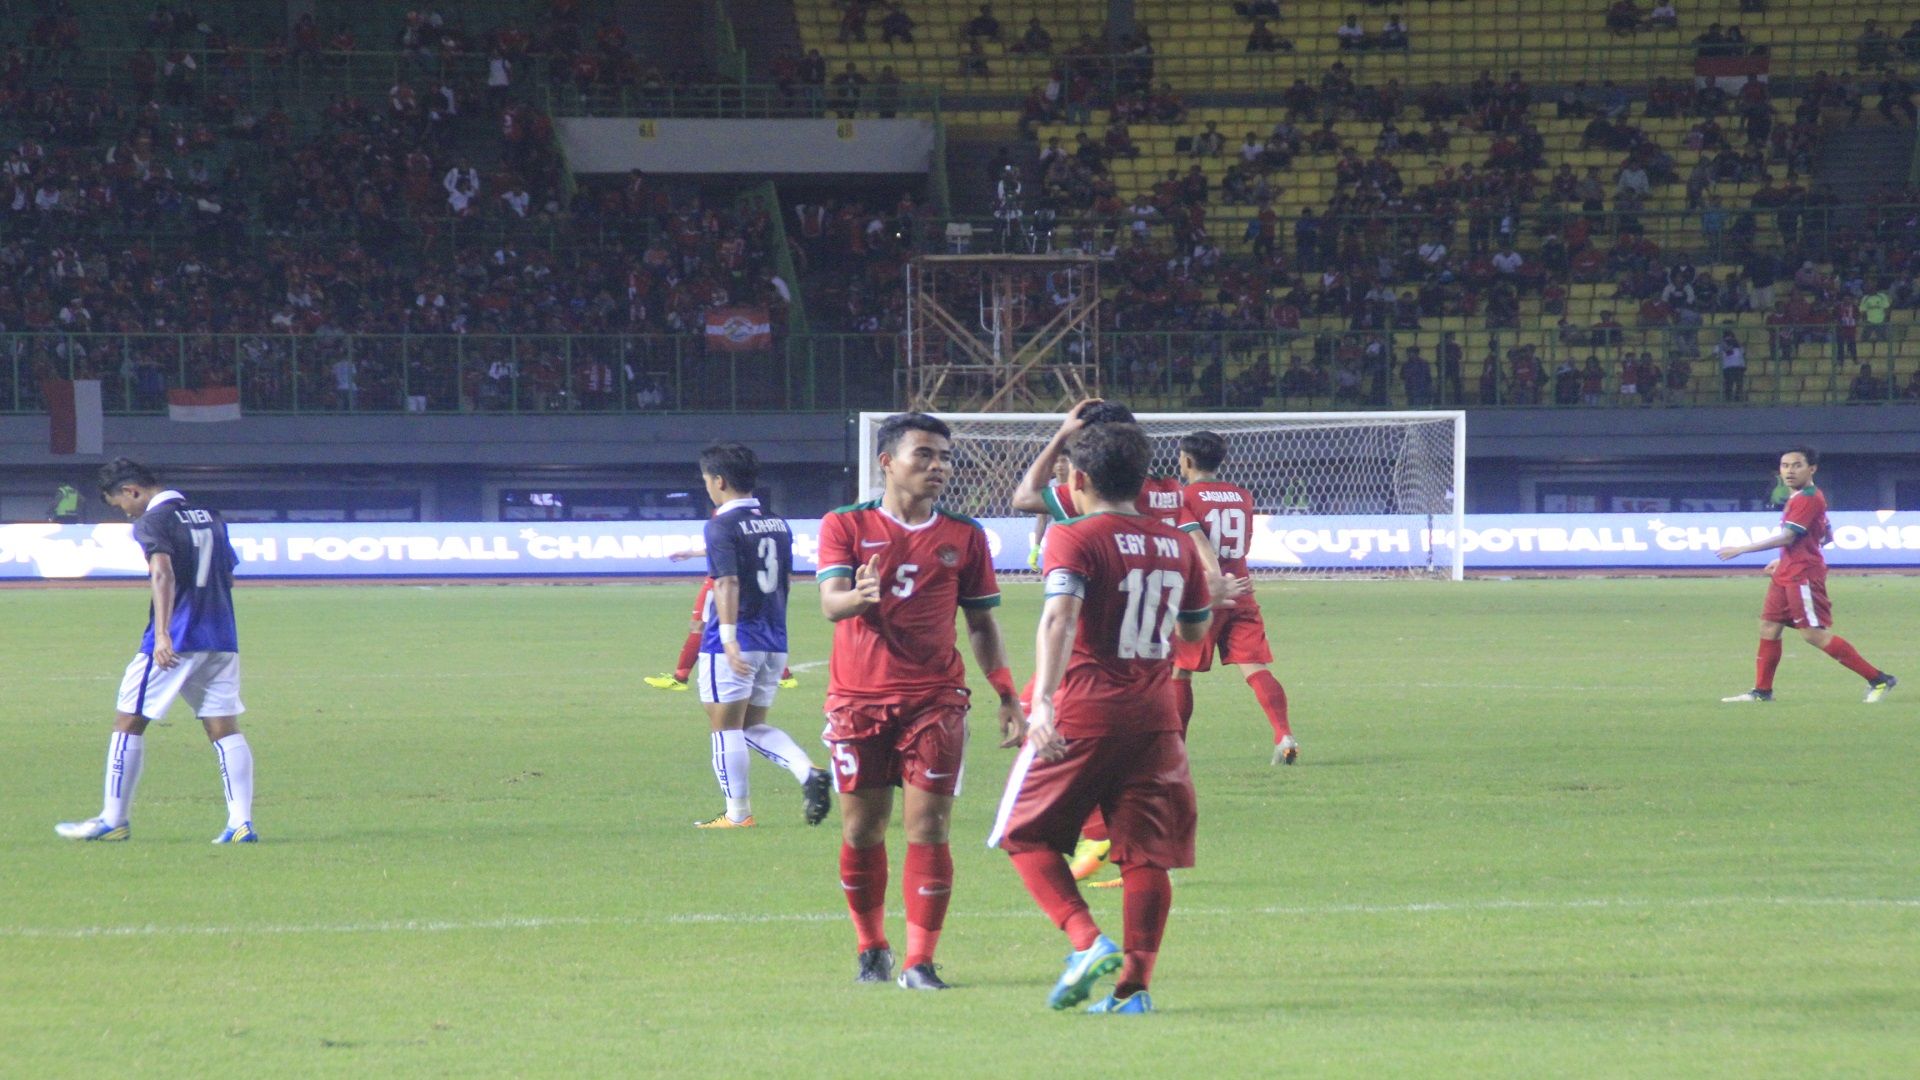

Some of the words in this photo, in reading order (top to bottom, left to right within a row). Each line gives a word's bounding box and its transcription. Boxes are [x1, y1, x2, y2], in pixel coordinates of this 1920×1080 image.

[1198, 490, 1243, 503] SAGHARA
[287, 536, 519, 561] FOOTBALL
[1114, 533, 1146, 556] EGY
[1204, 508, 1246, 559] 19
[1420, 527, 1648, 552] FOOTBALL
[190, 527, 214, 587] 7
[757, 537, 779, 594] 3
[891, 563, 918, 598] 5
[1118, 568, 1184, 659] 10
[836, 743, 858, 776] 5
